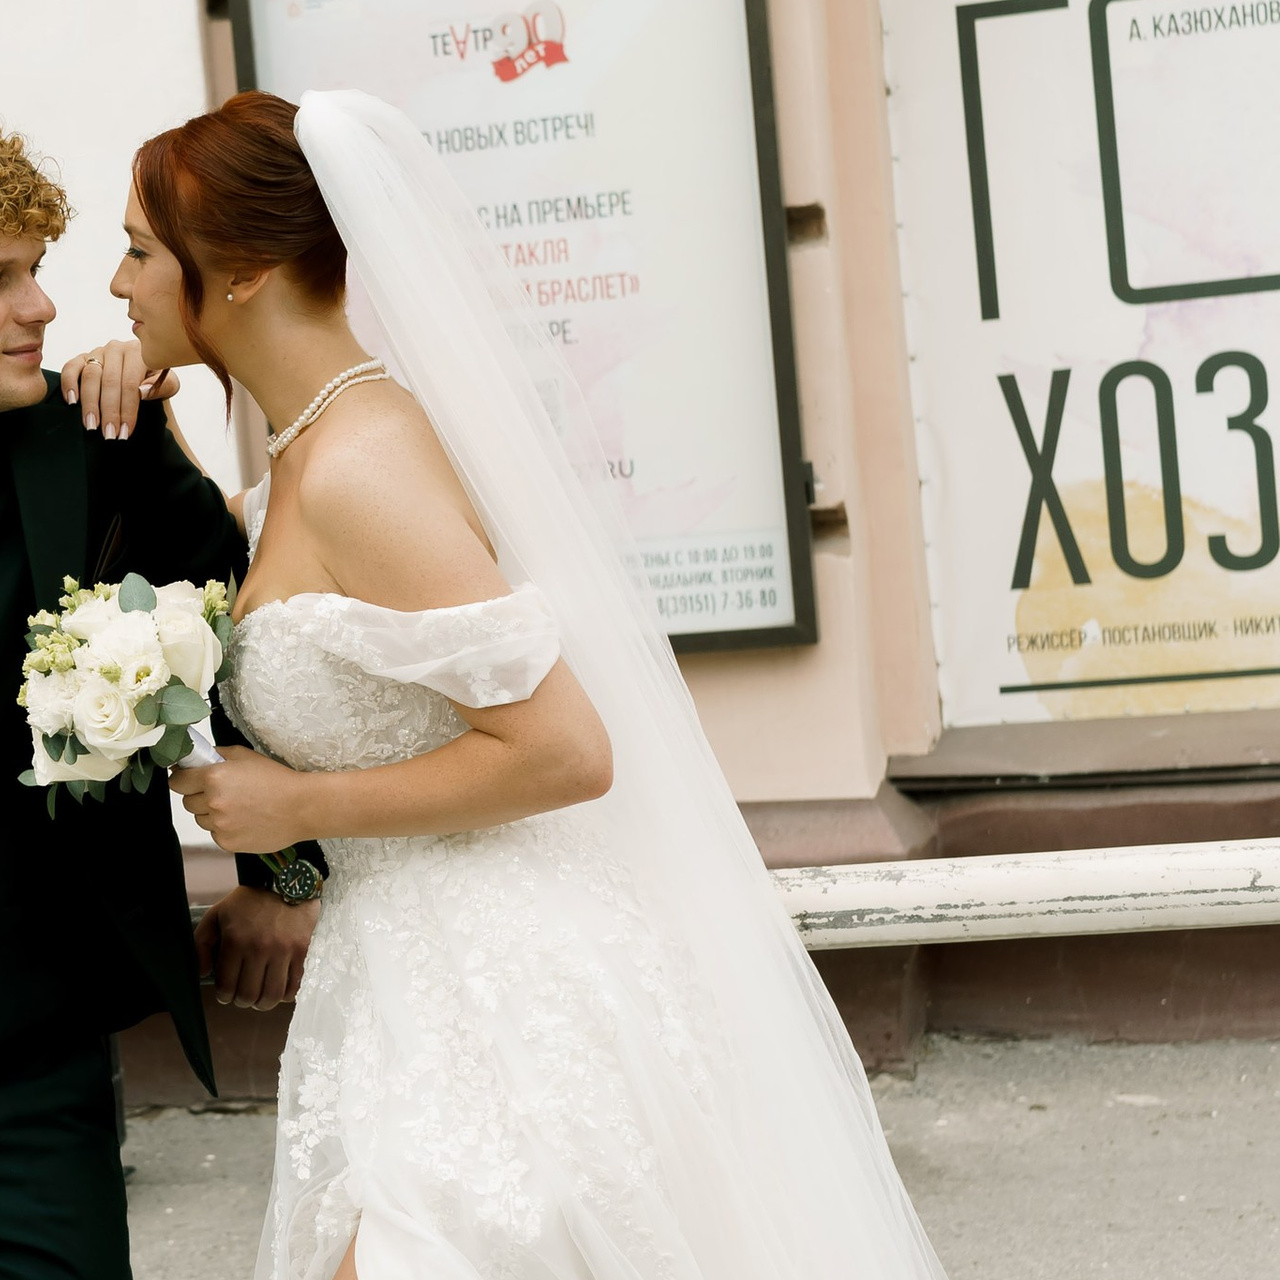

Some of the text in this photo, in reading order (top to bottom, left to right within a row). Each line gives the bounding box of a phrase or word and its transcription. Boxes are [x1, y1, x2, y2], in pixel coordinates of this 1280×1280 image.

[1129, 0, 1280, 42] А. КАЗЮХАНОВ
[436, 122, 509, 155] НОВЫХ
[513, 112, 596, 146] ВСТРЕЧ!
[494, 203, 523, 230] НА
[527, 189, 633, 226] ПРЕМЬЕРЕ
[997, 349, 1280, 591] ХОЗ
[1103, 619, 1218, 648] ПОСТАНОВЩИК
